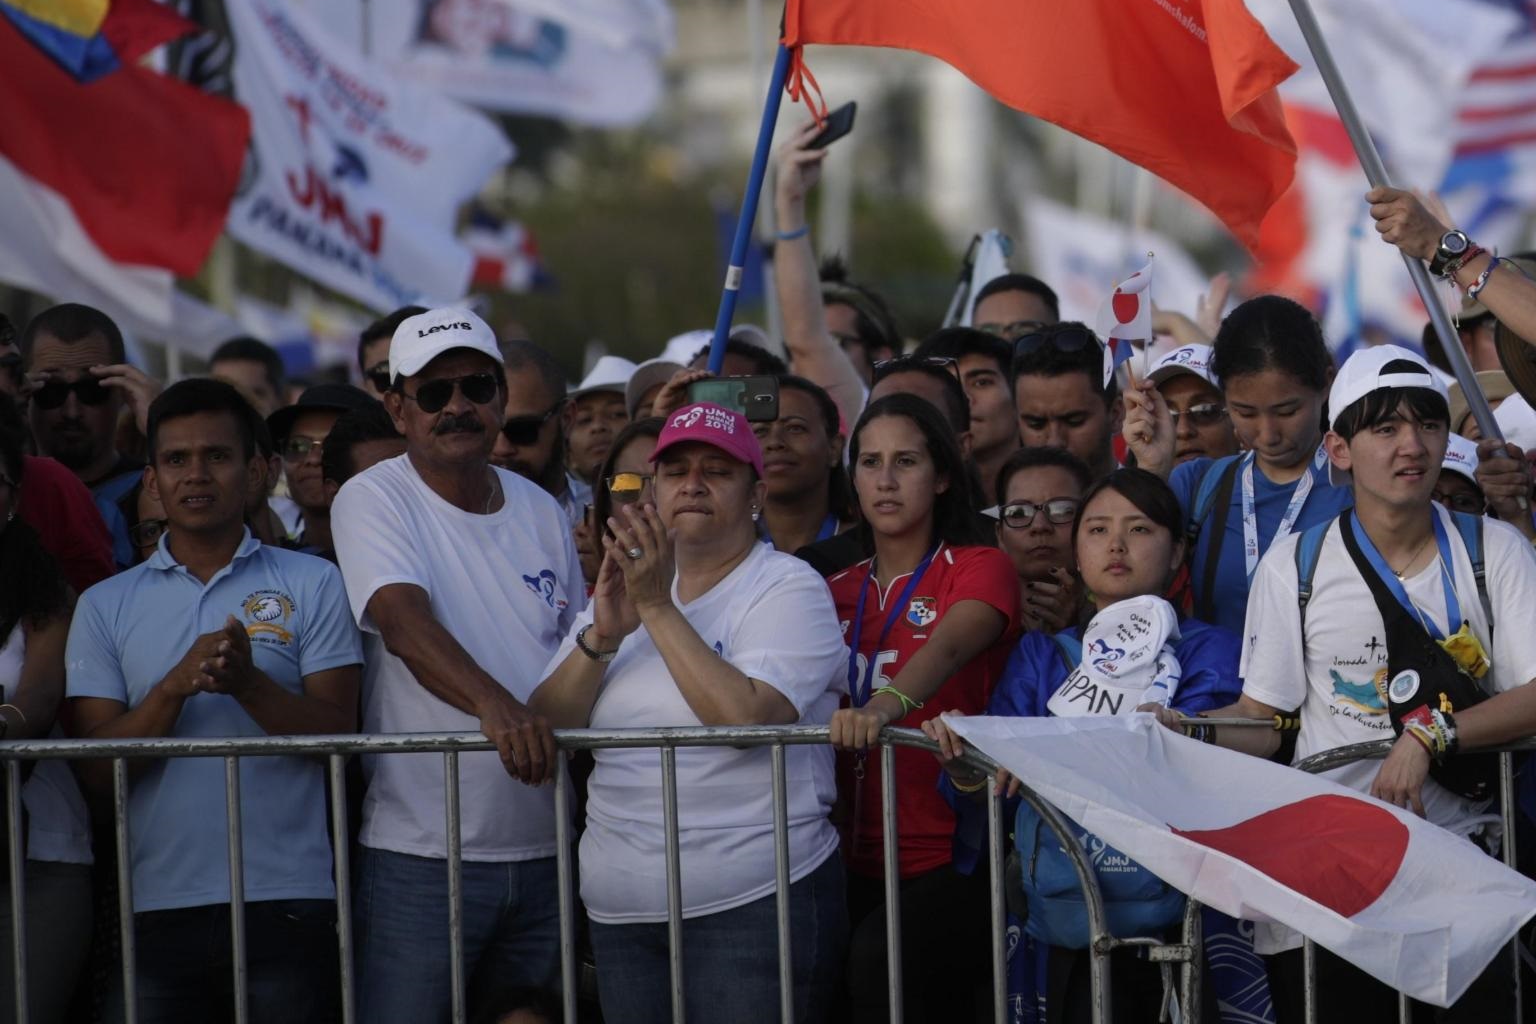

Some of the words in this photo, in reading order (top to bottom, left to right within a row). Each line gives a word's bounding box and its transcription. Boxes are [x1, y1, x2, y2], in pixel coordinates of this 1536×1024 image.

[705, 407, 735, 423] JMJ
[704, 419, 735, 435] 2019
[1333, 655, 1368, 666] Jornada
[1103, 856, 1130, 867] JMJ
